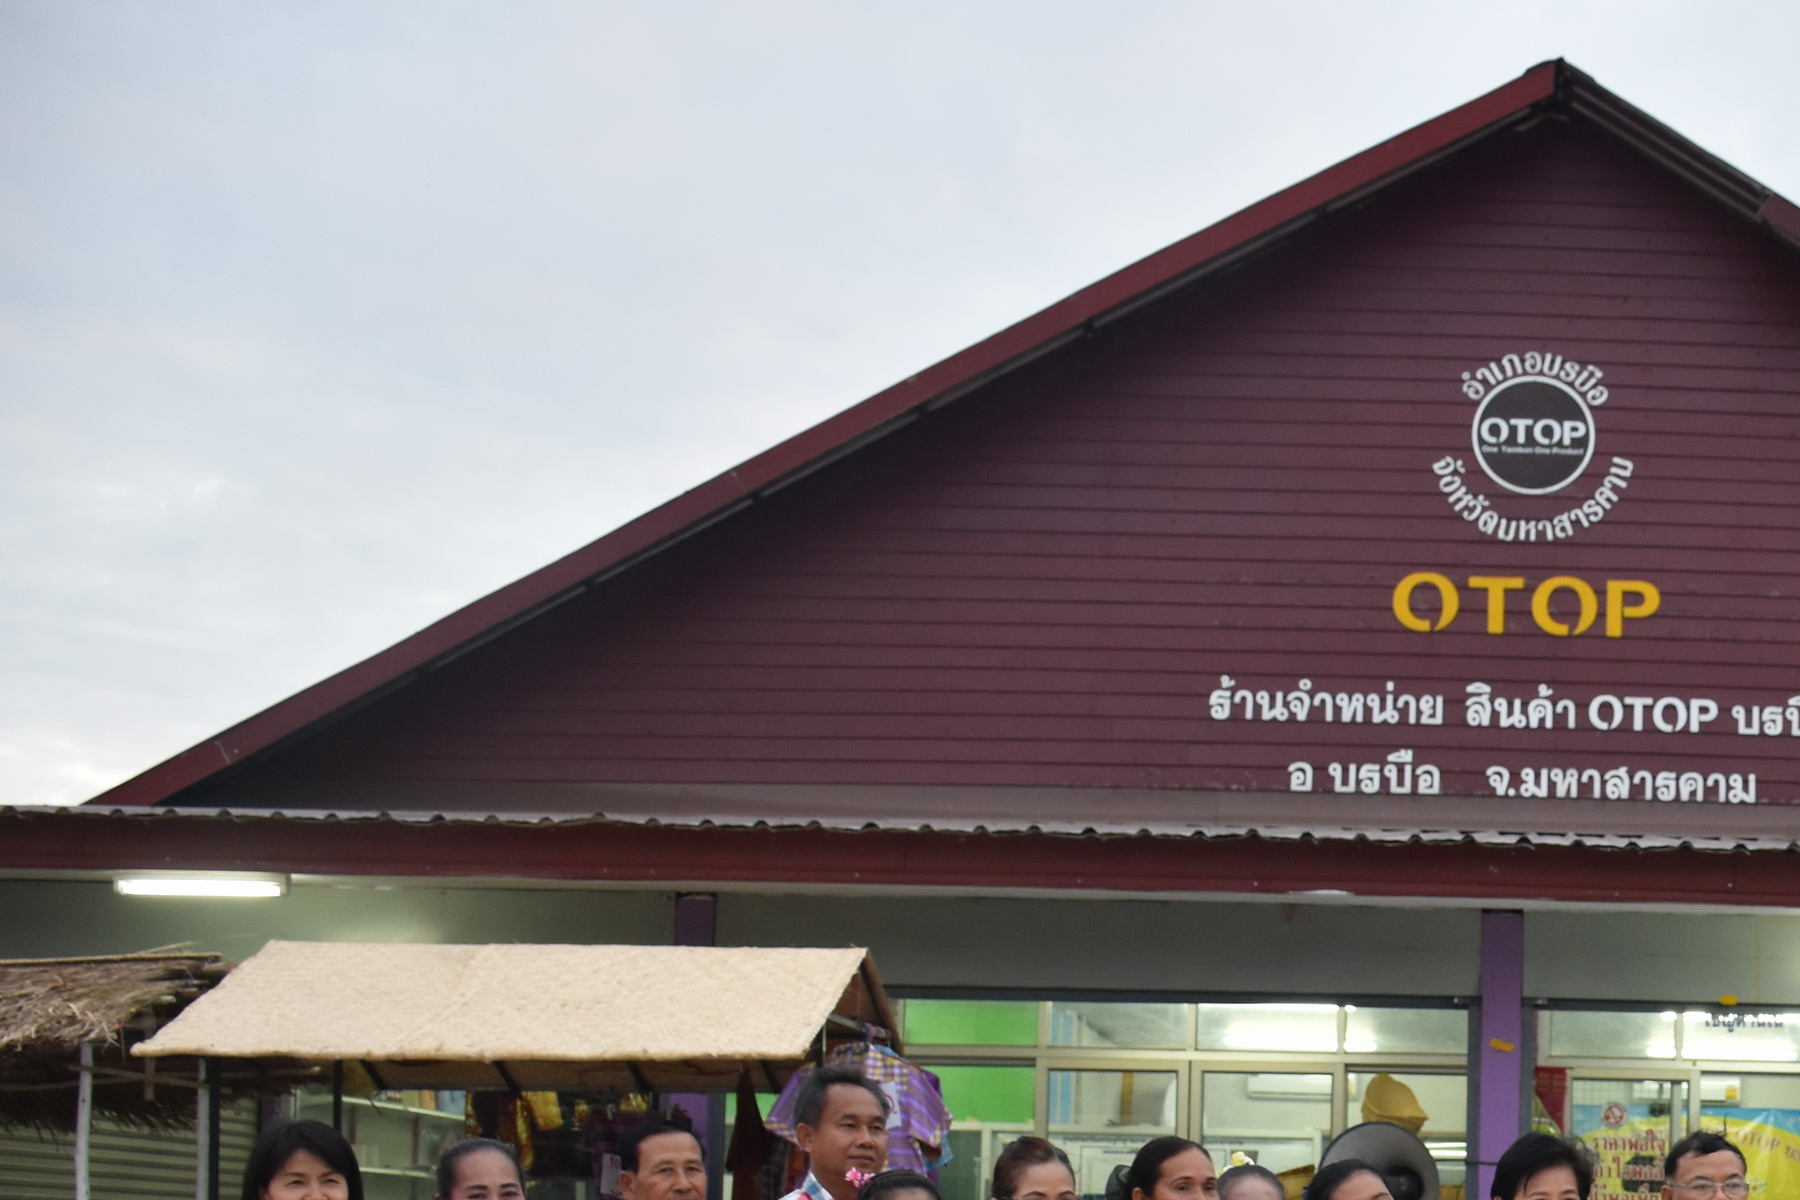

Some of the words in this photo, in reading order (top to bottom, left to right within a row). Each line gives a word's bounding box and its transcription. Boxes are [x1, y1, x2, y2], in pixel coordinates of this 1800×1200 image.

[1461, 351, 1609, 406] อำเภอบรบือ
[1480, 417, 1588, 447] OTOP
[1432, 455, 1634, 542] จังหวัดมหาสารคาม
[1392, 571, 1661, 638] OTOP
[1208, 674, 1444, 726] ร้านจำหน่าย
[1465, 681, 1577, 730] สินค้า
[1587, 694, 1719, 734] OTOP
[1328, 748, 1441, 796] บรบือ
[1485, 764, 1757, 804] จ.มหาสารคาม
